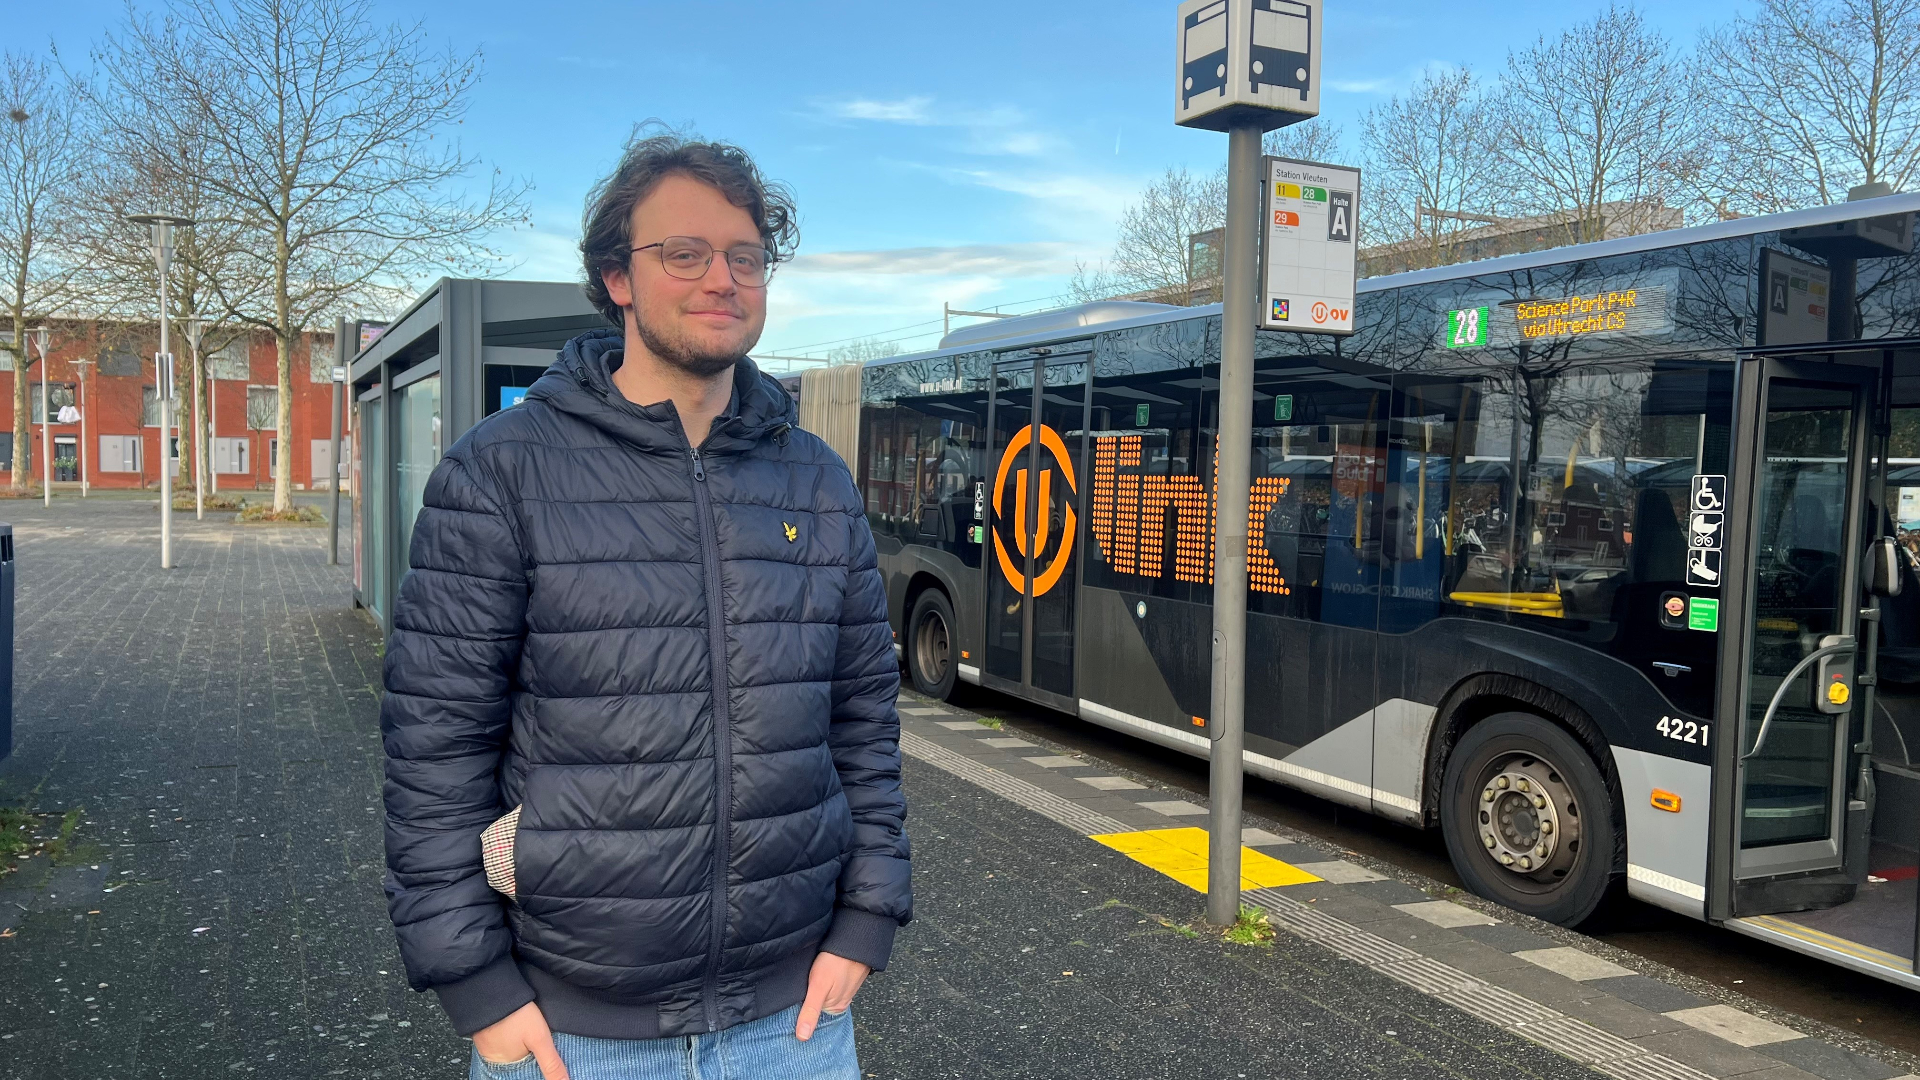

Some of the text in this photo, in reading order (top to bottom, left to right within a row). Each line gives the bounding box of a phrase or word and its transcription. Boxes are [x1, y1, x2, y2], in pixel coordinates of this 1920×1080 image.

[1276, 168, 1328, 184] Station Vleuten
[1277, 184, 1286, 196] 11
[1304, 188, 1315, 200] 28
[1333, 197, 1349, 207] Halte
[1275, 212, 1288, 224] 29
[1331, 206, 1348, 236] A
[1516, 290, 1637, 320] Science Park P+R
[1330, 308, 1348, 320] OV
[1454, 309, 1480, 345] 28
[1523, 312, 1626, 338] via Utrecht CS
[1656, 716, 1709, 747] 4221
